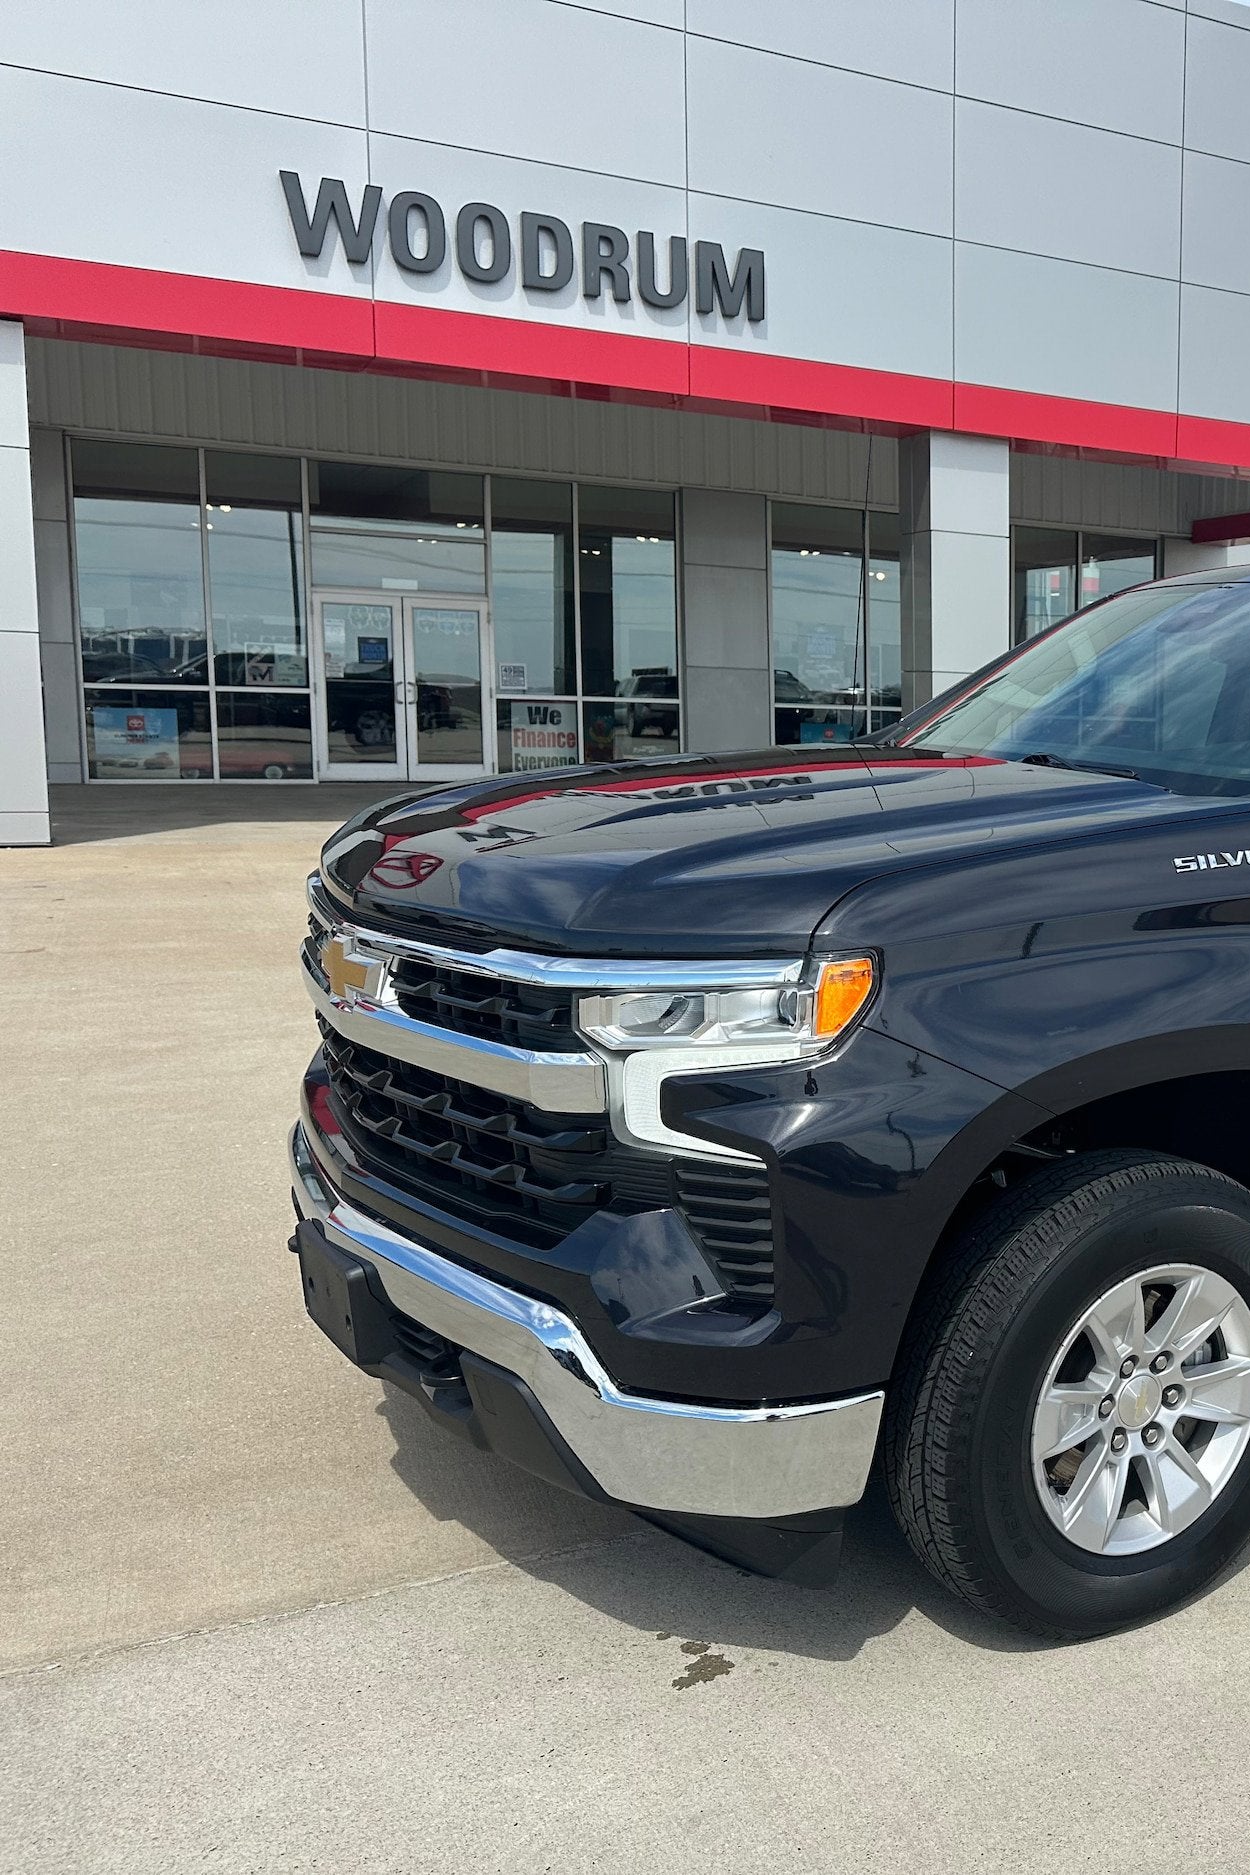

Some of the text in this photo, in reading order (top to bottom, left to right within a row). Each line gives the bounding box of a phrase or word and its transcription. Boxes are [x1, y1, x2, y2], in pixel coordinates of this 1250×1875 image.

[279, 170, 765, 322] WOODRUM
[527, 706, 562, 725] We
[513, 729, 576, 748] Finance
